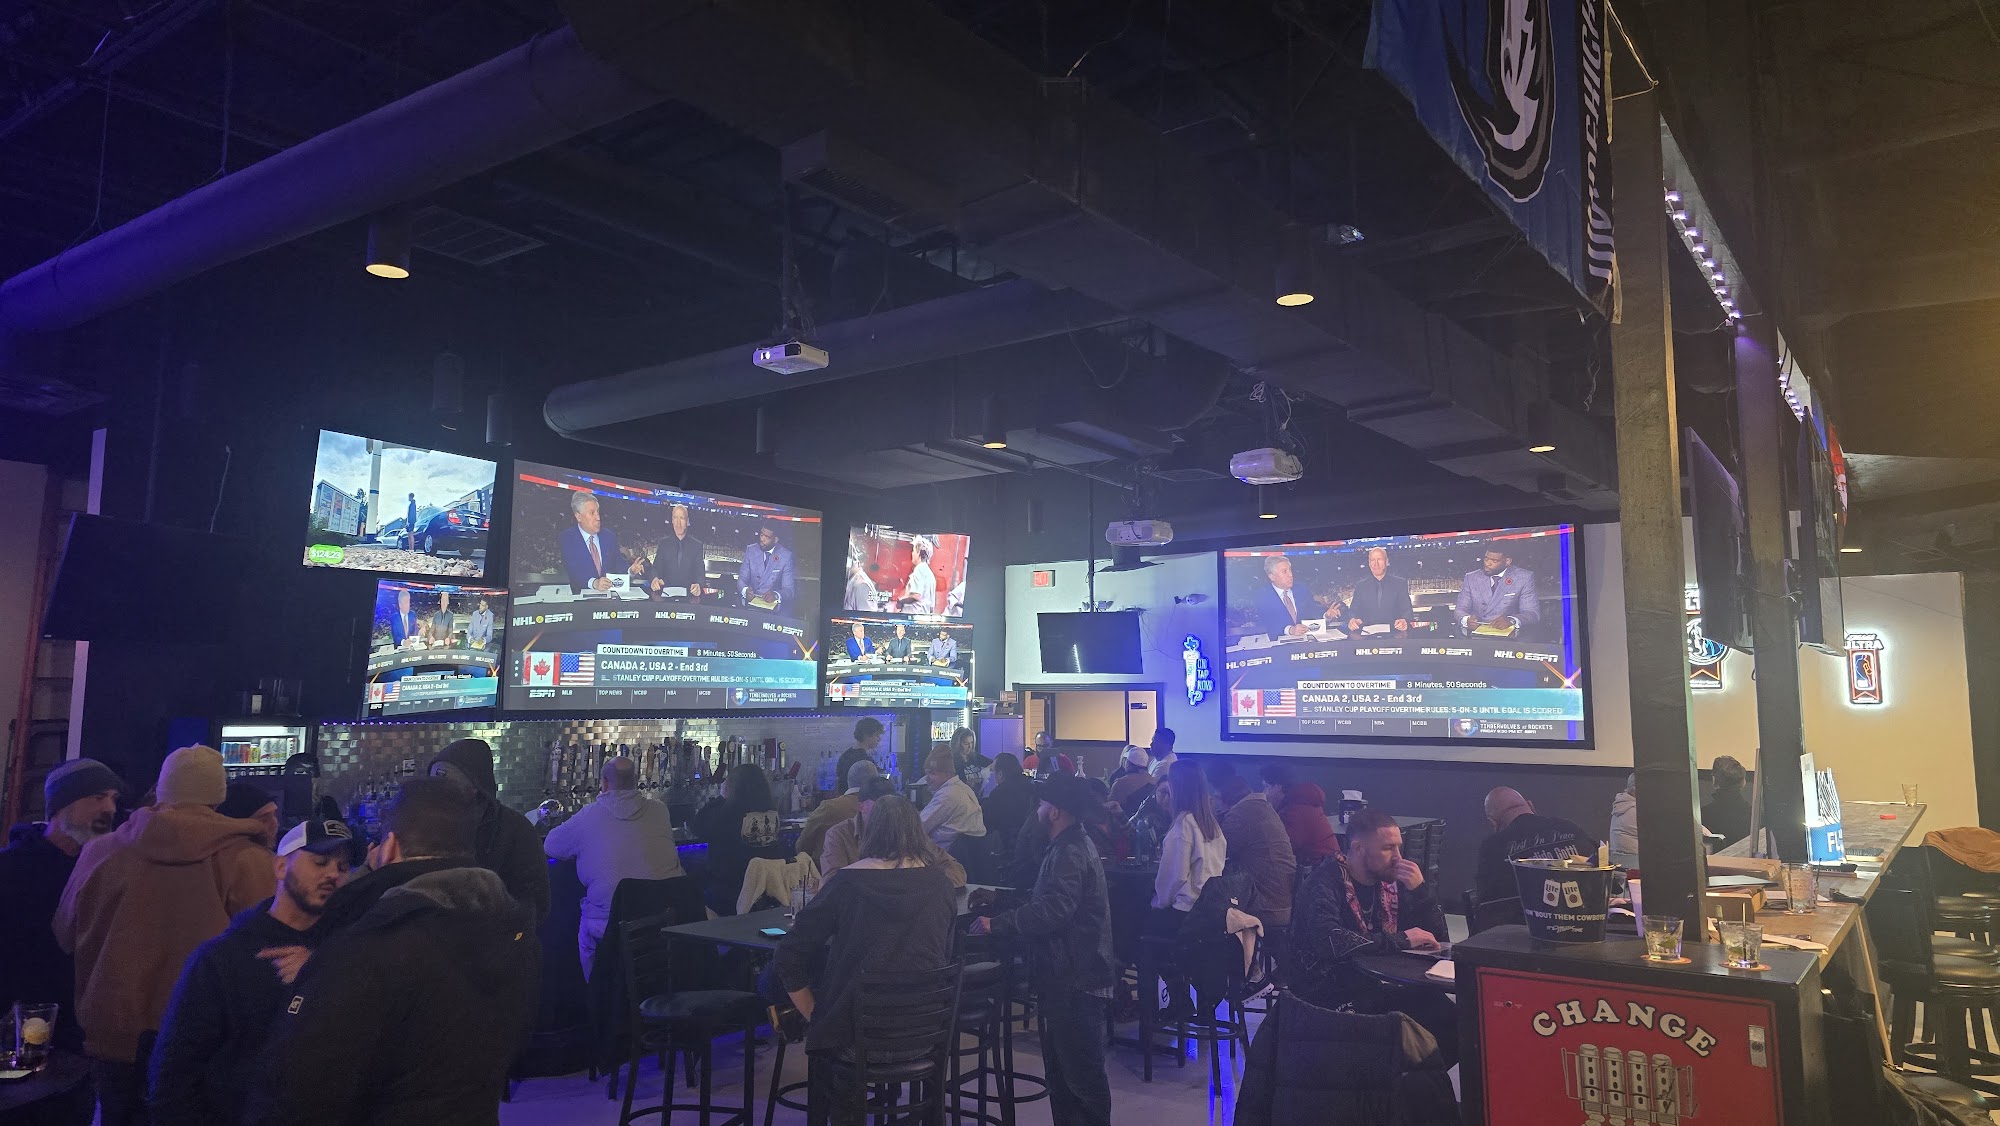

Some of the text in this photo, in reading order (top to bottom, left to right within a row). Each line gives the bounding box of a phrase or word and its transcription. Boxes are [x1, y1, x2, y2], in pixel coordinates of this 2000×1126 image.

[512, 613, 574, 626] NHL ESPN
[592, 611, 640, 620] NHL ESPN
[676, 612, 696, 620] ESPN
[710, 615, 749, 627] NHL ESPN
[762, 622, 804, 637] NHL ESPN
[602, 646, 644, 655] COUNTDOWN
[653, 648, 684, 656] OVERTIME
[1291, 650, 1338, 661] NHL ESPN
[1356, 647, 1403, 656] NHL ESPN
[1446, 648, 1472, 656] ESPN
[1494, 650, 1559, 663] NHL ESPN
[601, 660, 638, 670] CANADA
[639, 661, 648, 672] 2,
[648, 662, 667, 671] USA
[667, 662, 674, 671] 2
[680, 662, 694, 672] End
[695, 663, 709, 672] 3rd
[1226, 657, 1272, 670] HL ESPN
[612, 674, 641, 682] STANLEY
[642, 674, 655, 682] CUP
[682, 675, 710, 683] OVERTIME
[1414, 681, 1445, 689] Minutes,
[1456, 681, 1487, 689] Seconds
[529, 689, 556, 698] ESPN
[1302, 695, 1340, 703] CANADA
[1341, 695, 1350, 704] 2,
[1351, 695, 1371, 703] USA
[1373, 695, 1380, 703] 2
[1387, 694, 1404, 703] End
[1406, 694, 1422, 703] 3rd
[1510, 840, 1526, 853] Rest
[1552, 830, 1575, 841] Peace
[1546, 884, 1559, 893] Lite
[1564, 886, 1578, 895] Lite
[1554, 913, 1575, 921] THEM
[1532, 999, 1717, 1058] CHANGE
